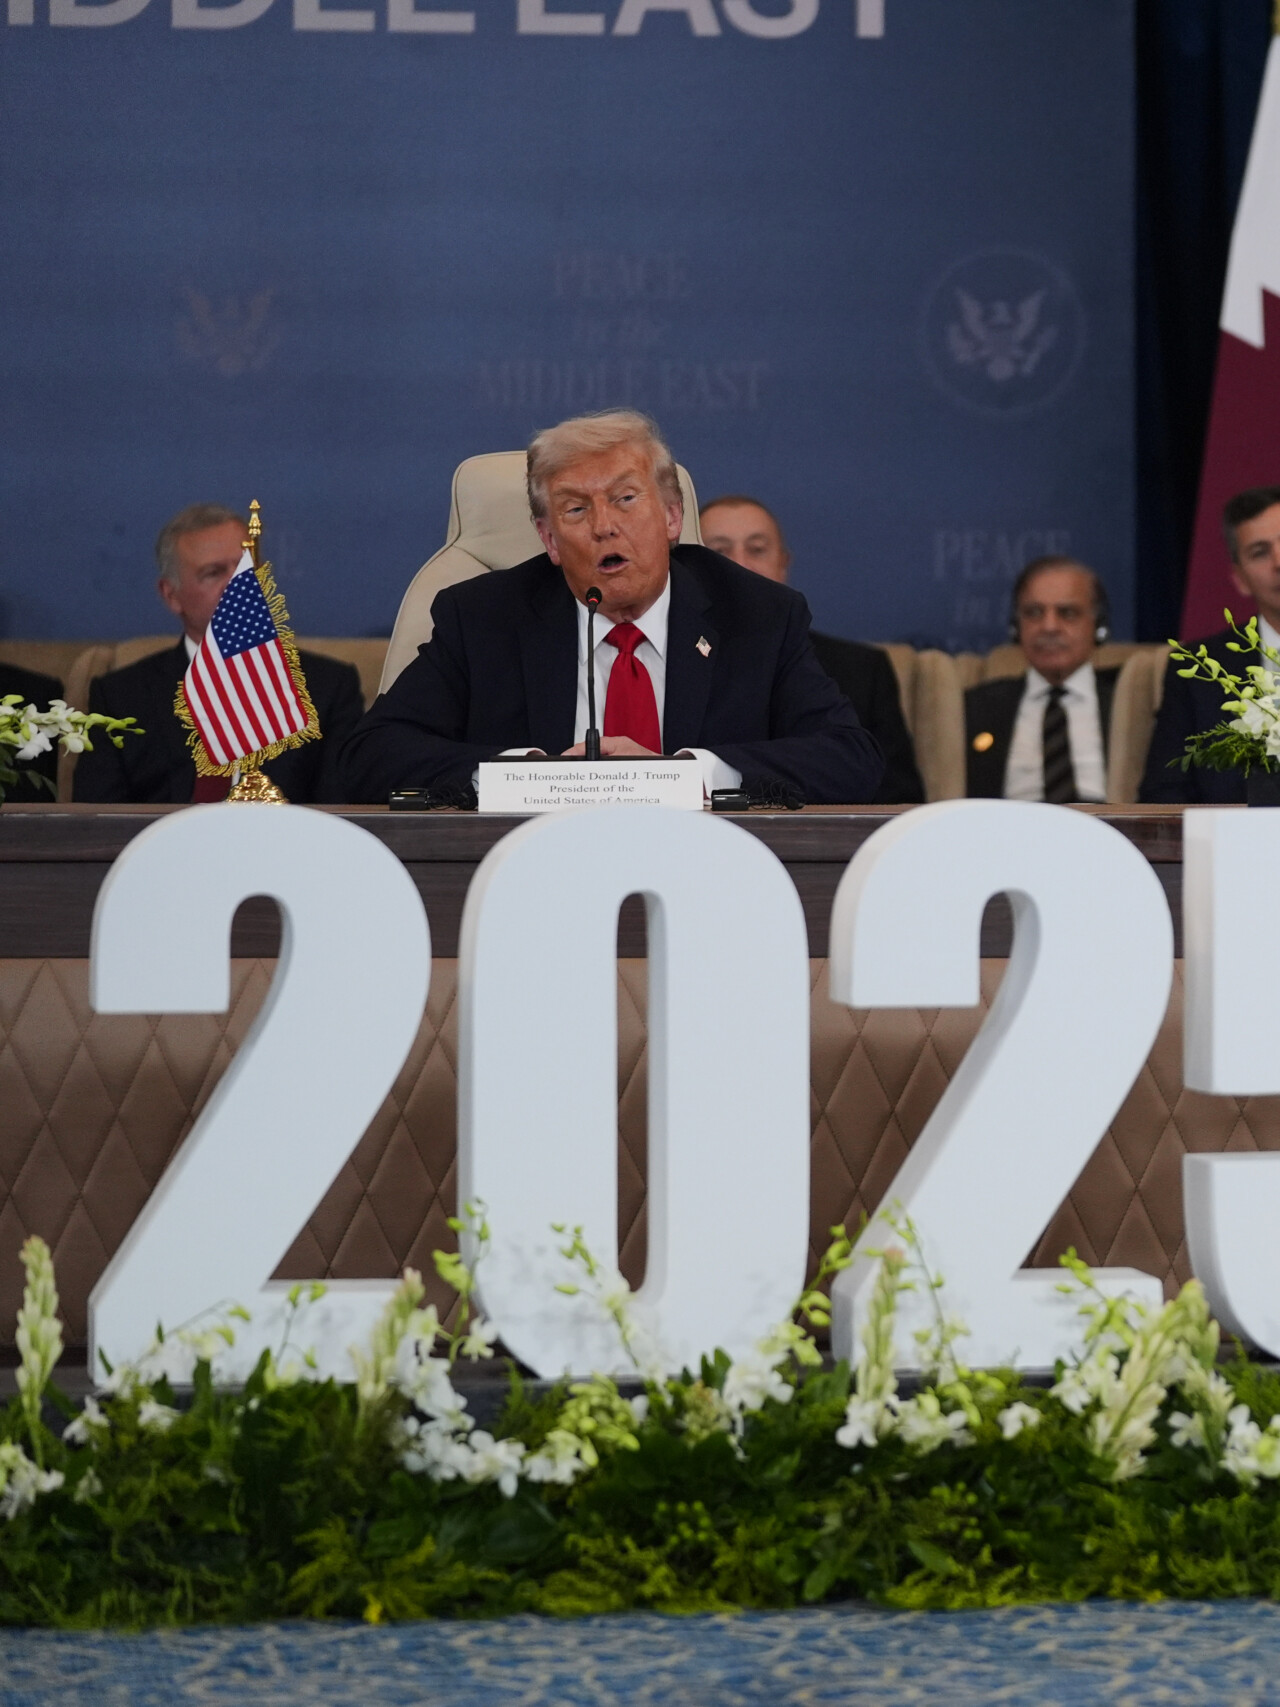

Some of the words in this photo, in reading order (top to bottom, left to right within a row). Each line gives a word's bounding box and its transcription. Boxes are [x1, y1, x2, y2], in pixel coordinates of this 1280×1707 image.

[661, 358, 770, 410] EAST
[503, 772, 525, 781] The
[528, 772, 585, 781] Honorable
[589, 772, 629, 781] Donald
[631, 771, 641, 780] J.
[644, 771, 680, 781] Trump
[549, 785, 600, 793] President
[603, 785, 616, 793] of
[618, 784, 635, 792] the
[523, 796, 560, 805] United
[564, 796, 597, 805] States
[615, 796, 660, 804] America
